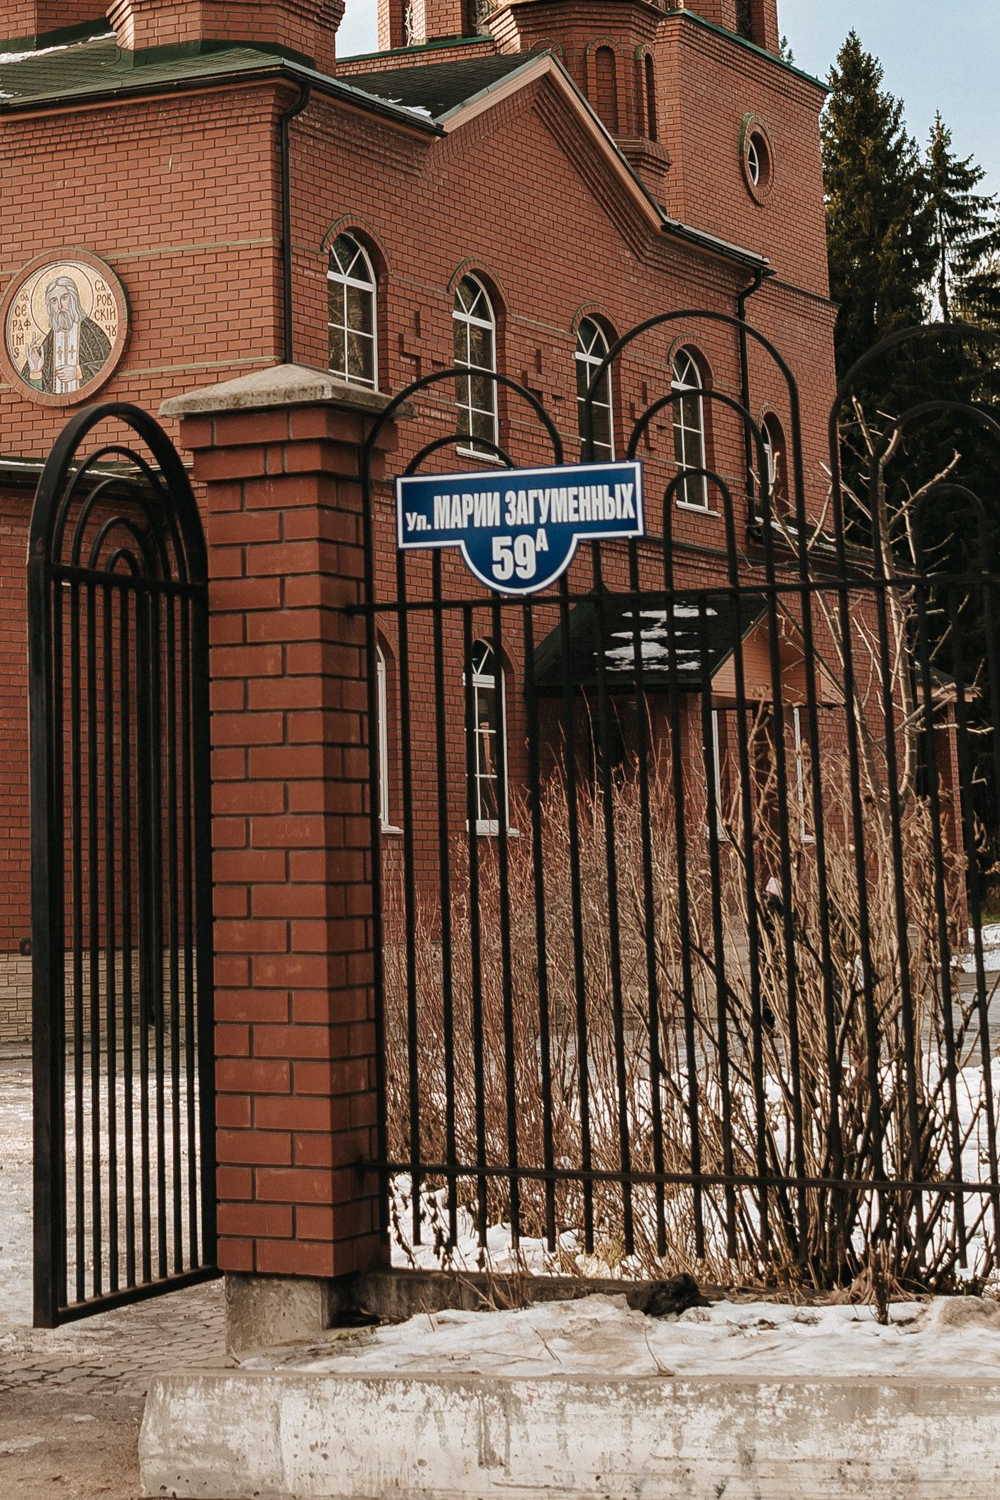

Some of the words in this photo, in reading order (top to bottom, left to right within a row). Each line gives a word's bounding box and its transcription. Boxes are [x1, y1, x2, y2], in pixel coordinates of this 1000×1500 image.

[405, 511, 432, 531] Ул.
[433, 491, 501, 530] МАРИИ
[505, 483, 636, 526] ЗАГУМЕННЫХ
